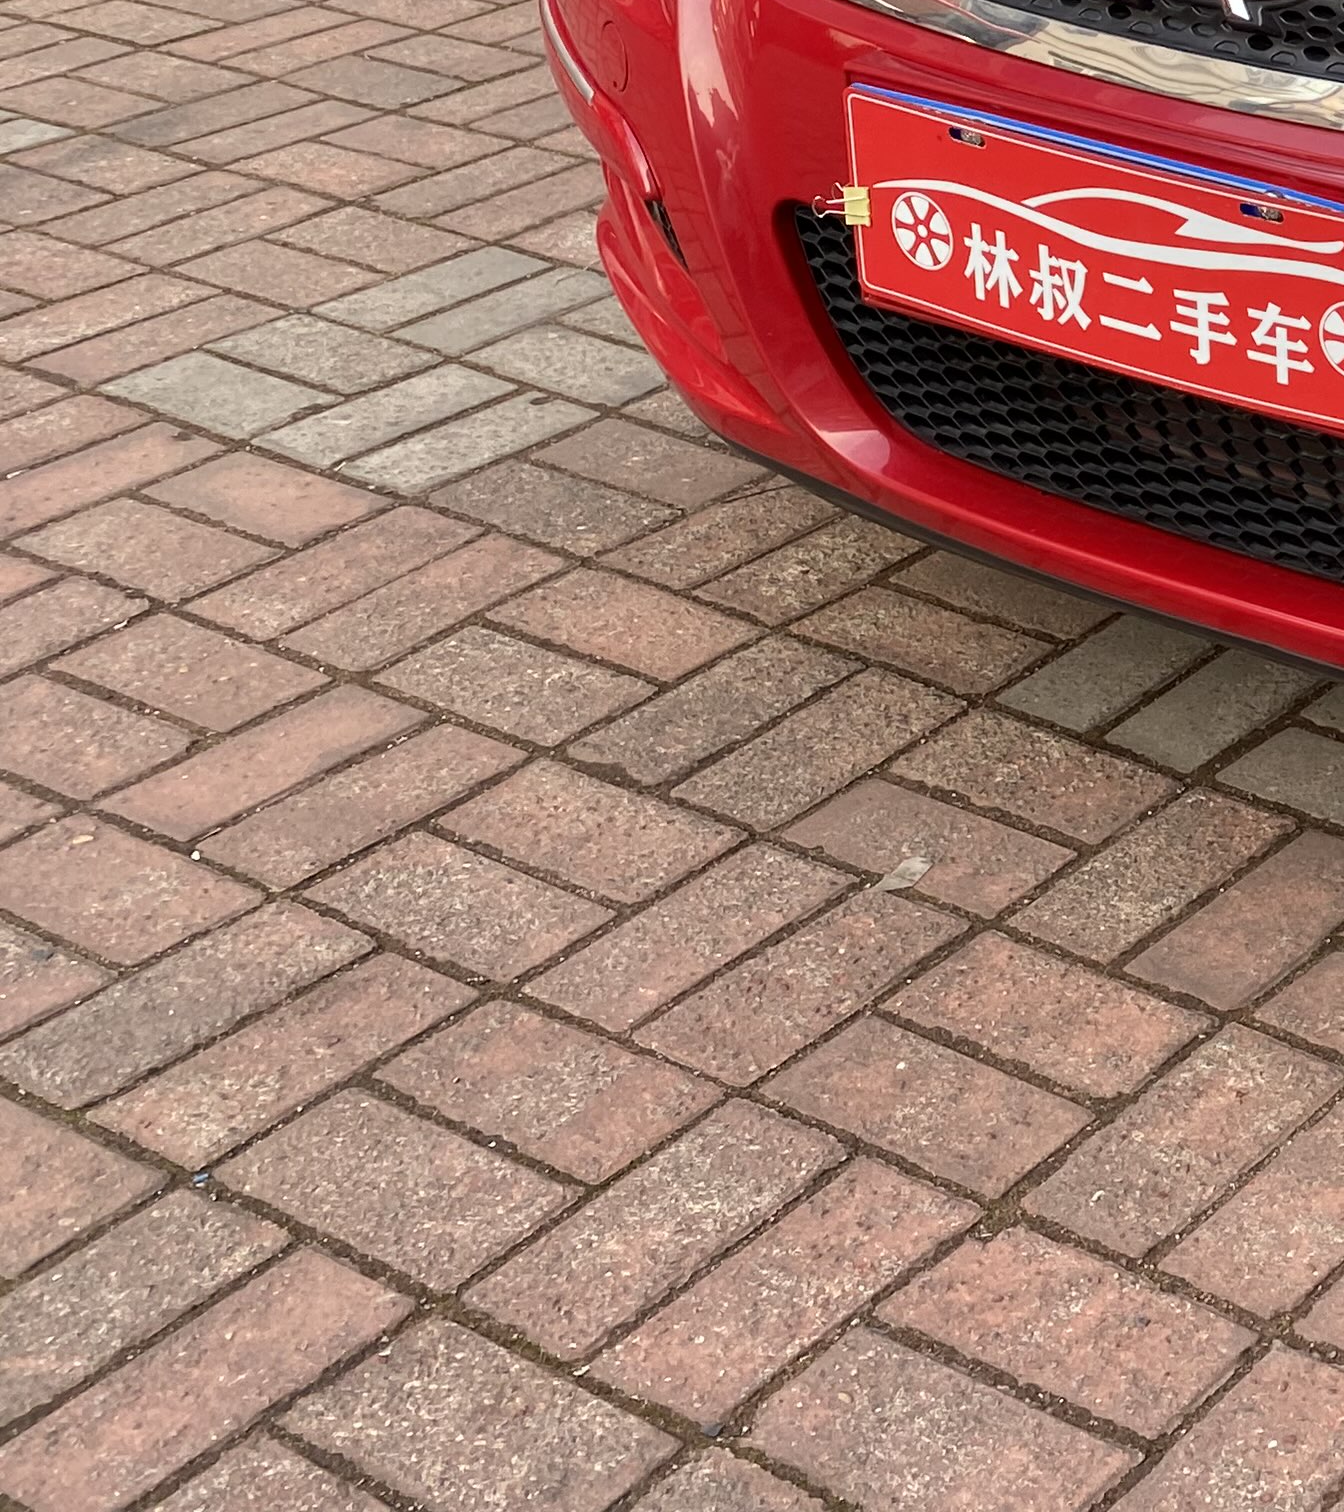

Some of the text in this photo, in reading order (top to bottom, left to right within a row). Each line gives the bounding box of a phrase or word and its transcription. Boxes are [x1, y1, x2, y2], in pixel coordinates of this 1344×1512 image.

[963, 222, 1316, 386] 林叔二手车
